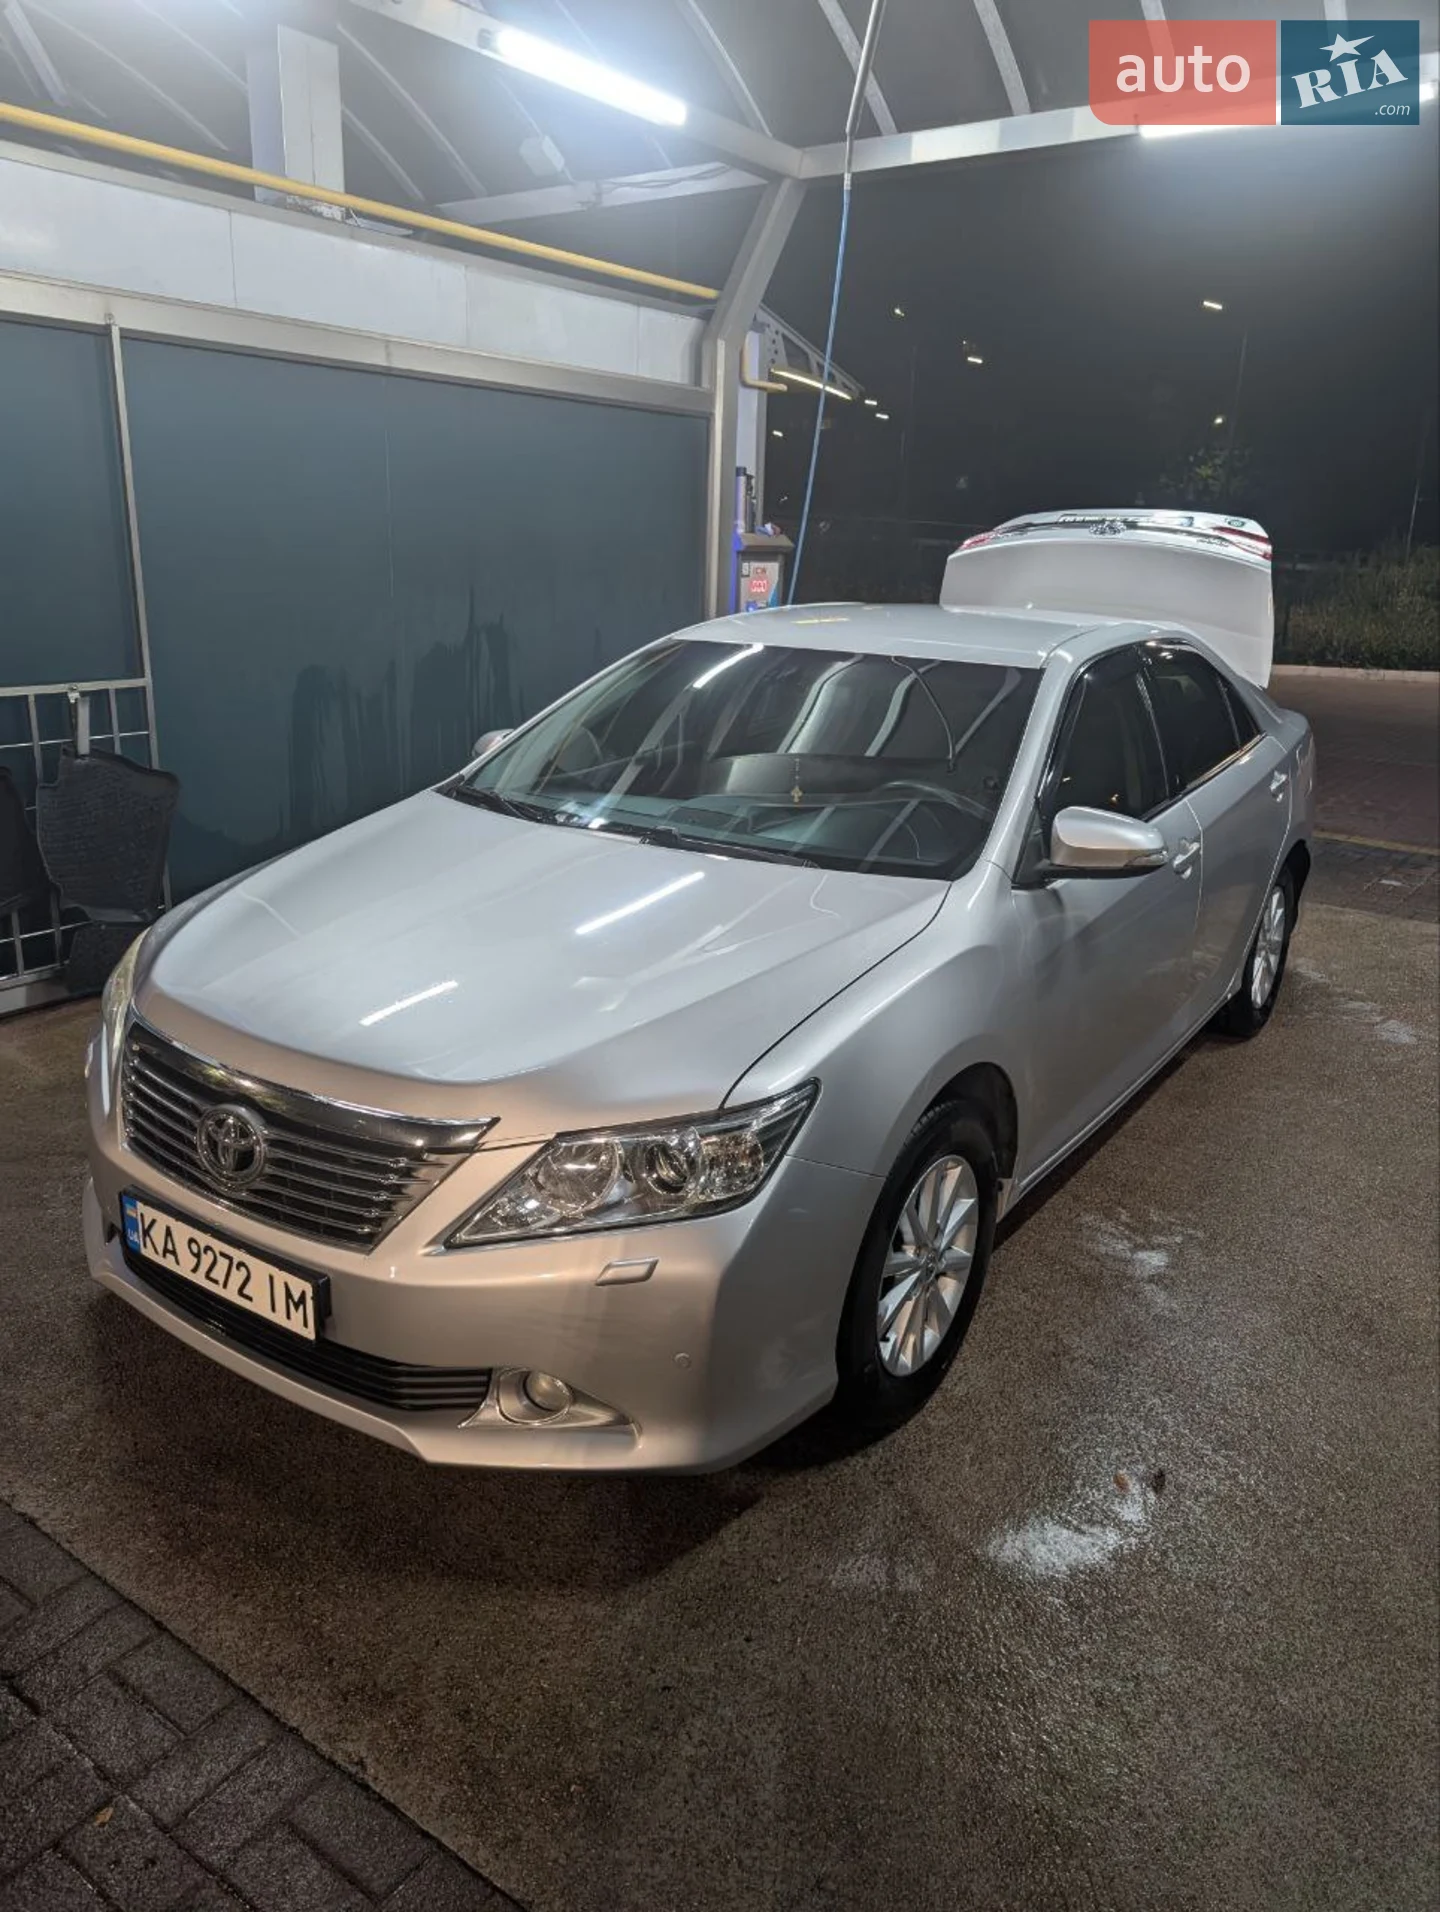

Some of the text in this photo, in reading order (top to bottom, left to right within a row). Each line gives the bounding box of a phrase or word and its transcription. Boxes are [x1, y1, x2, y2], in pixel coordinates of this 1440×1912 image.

[139, 1213, 309, 1328] KA 9272 IM
